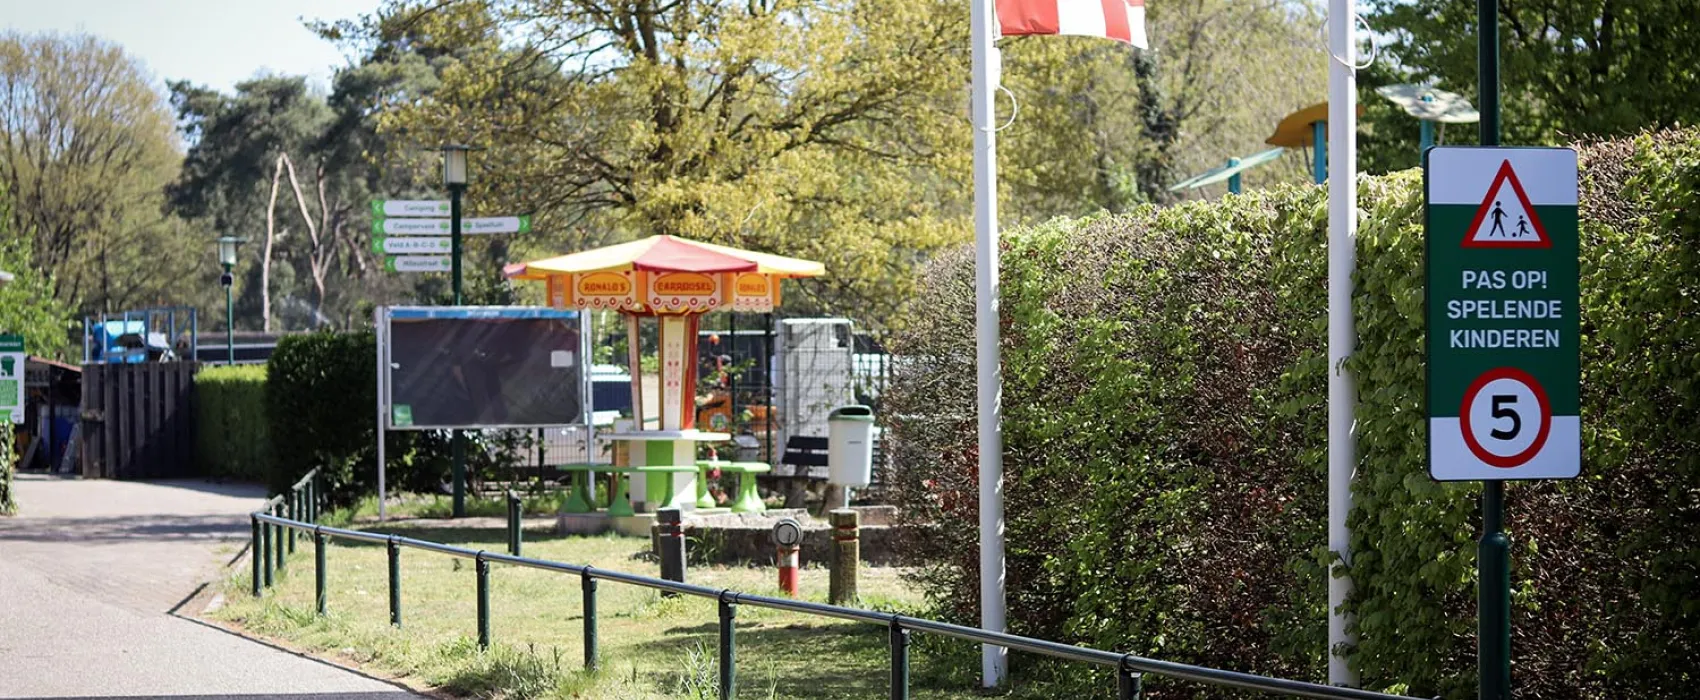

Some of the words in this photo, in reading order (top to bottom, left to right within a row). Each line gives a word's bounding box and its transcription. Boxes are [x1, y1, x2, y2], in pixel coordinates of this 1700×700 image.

[1462, 270, 1506, 289] PAS
[1511, 270, 1547, 289] OP!
[1447, 300, 1562, 319] SPELENDE
[1450, 329, 1560, 348] KINDEREN
[1490, 395, 1521, 441] 5
